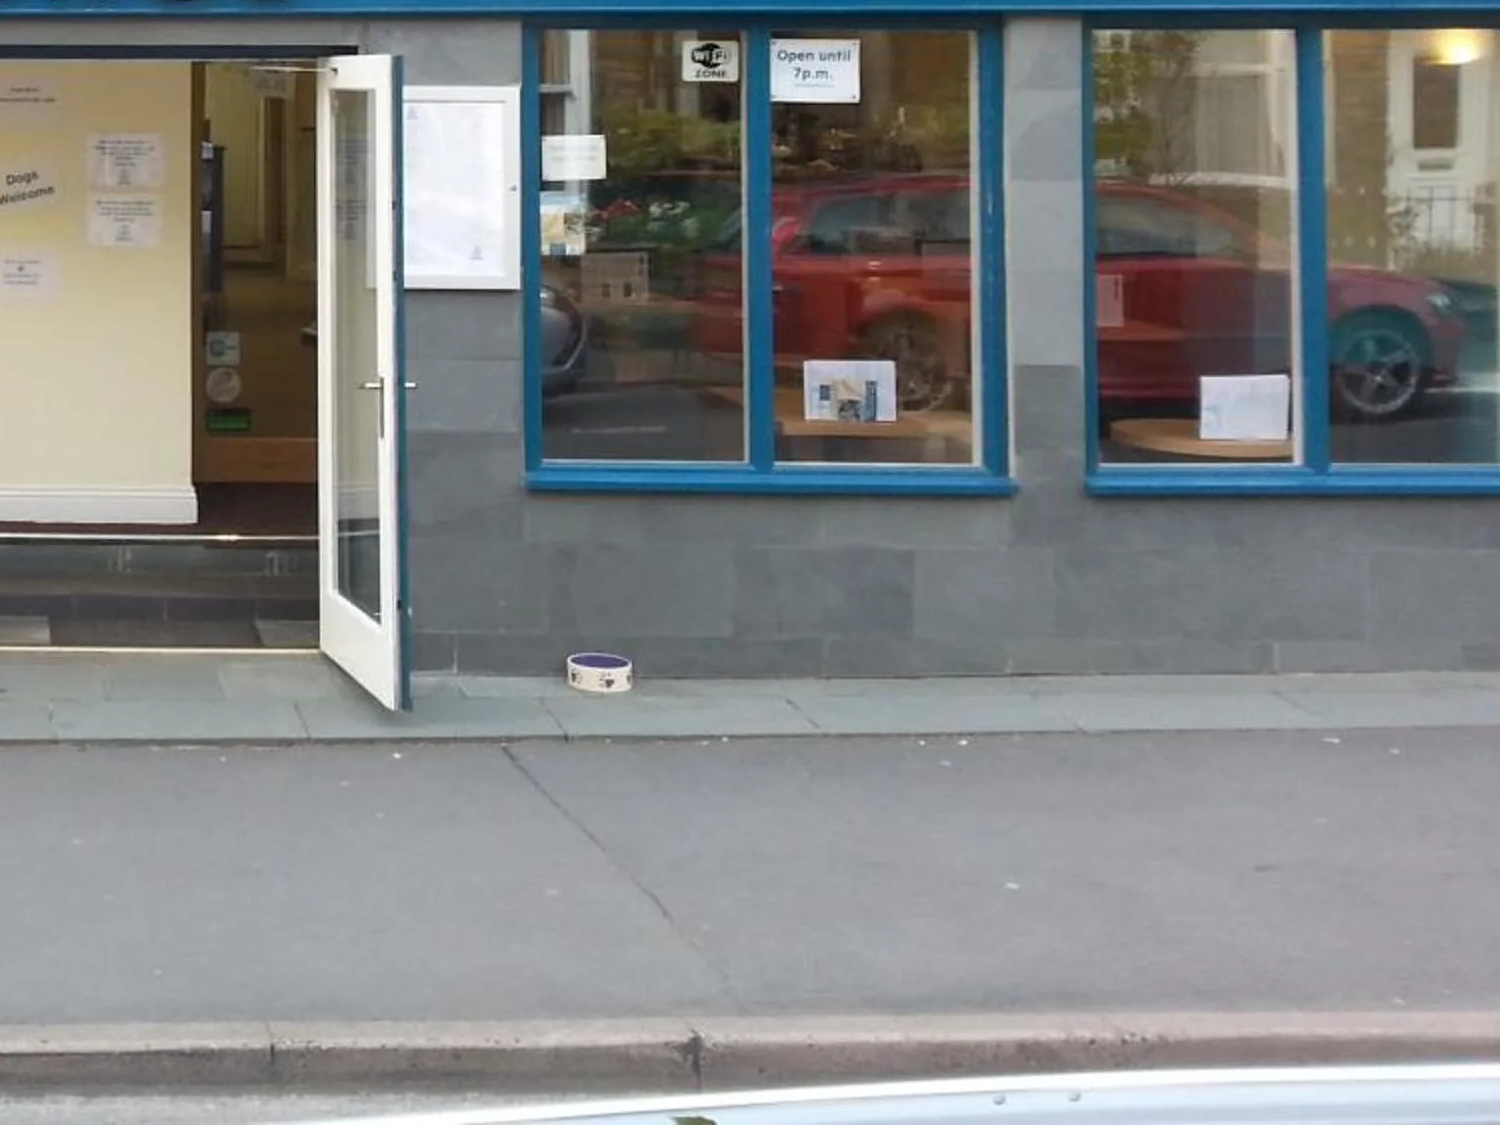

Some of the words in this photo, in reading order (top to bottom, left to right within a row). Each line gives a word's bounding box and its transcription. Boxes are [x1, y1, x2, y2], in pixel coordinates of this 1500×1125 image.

[776, 49, 815, 63] Open
[819, 49, 851, 62] until
[5, 171, 38, 186] Dogs
